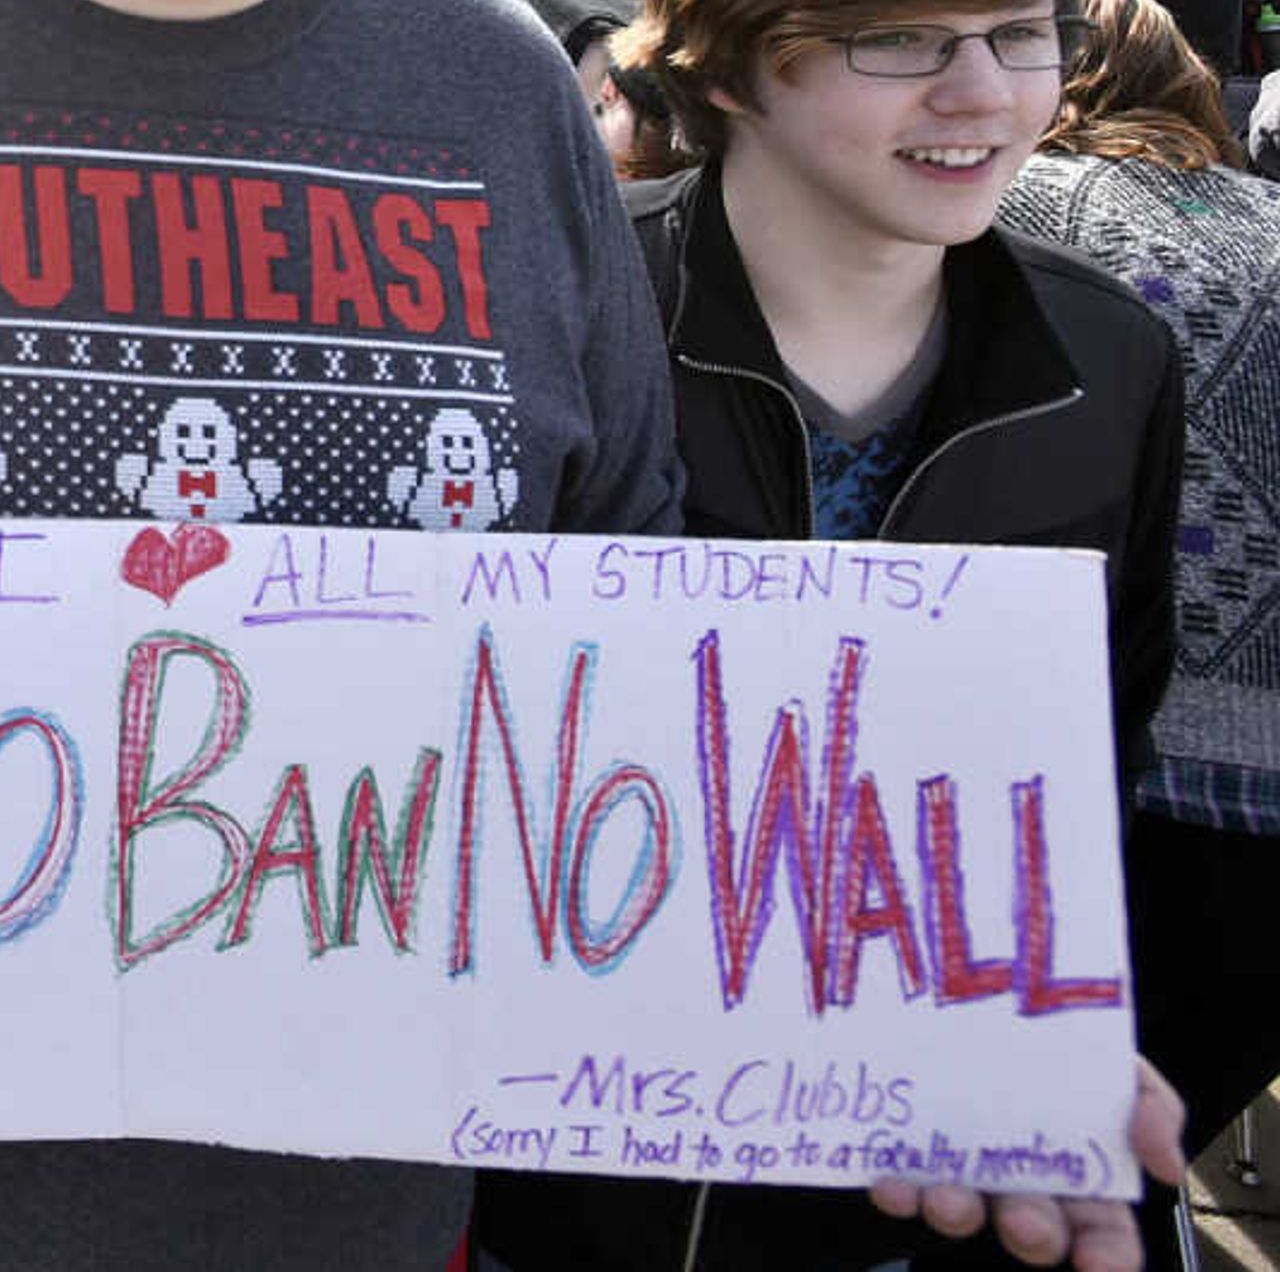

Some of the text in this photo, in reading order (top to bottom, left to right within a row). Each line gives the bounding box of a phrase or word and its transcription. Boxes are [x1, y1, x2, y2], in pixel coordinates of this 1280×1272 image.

[253, 533, 412, 608] ALL
[462, 538, 558, 605] MY
[593, 543, 969, 620] STUDENTS!
[715, 1060, 915, 1127] Clubbs
[569, 1125, 601, 1157] I
[621, 1126, 683, 1167] had
[691, 1133, 723, 1172] to
[735, 1142, 779, 1183] go
[785, 1132, 821, 1167] to
[828, 1143, 851, 1171] a
